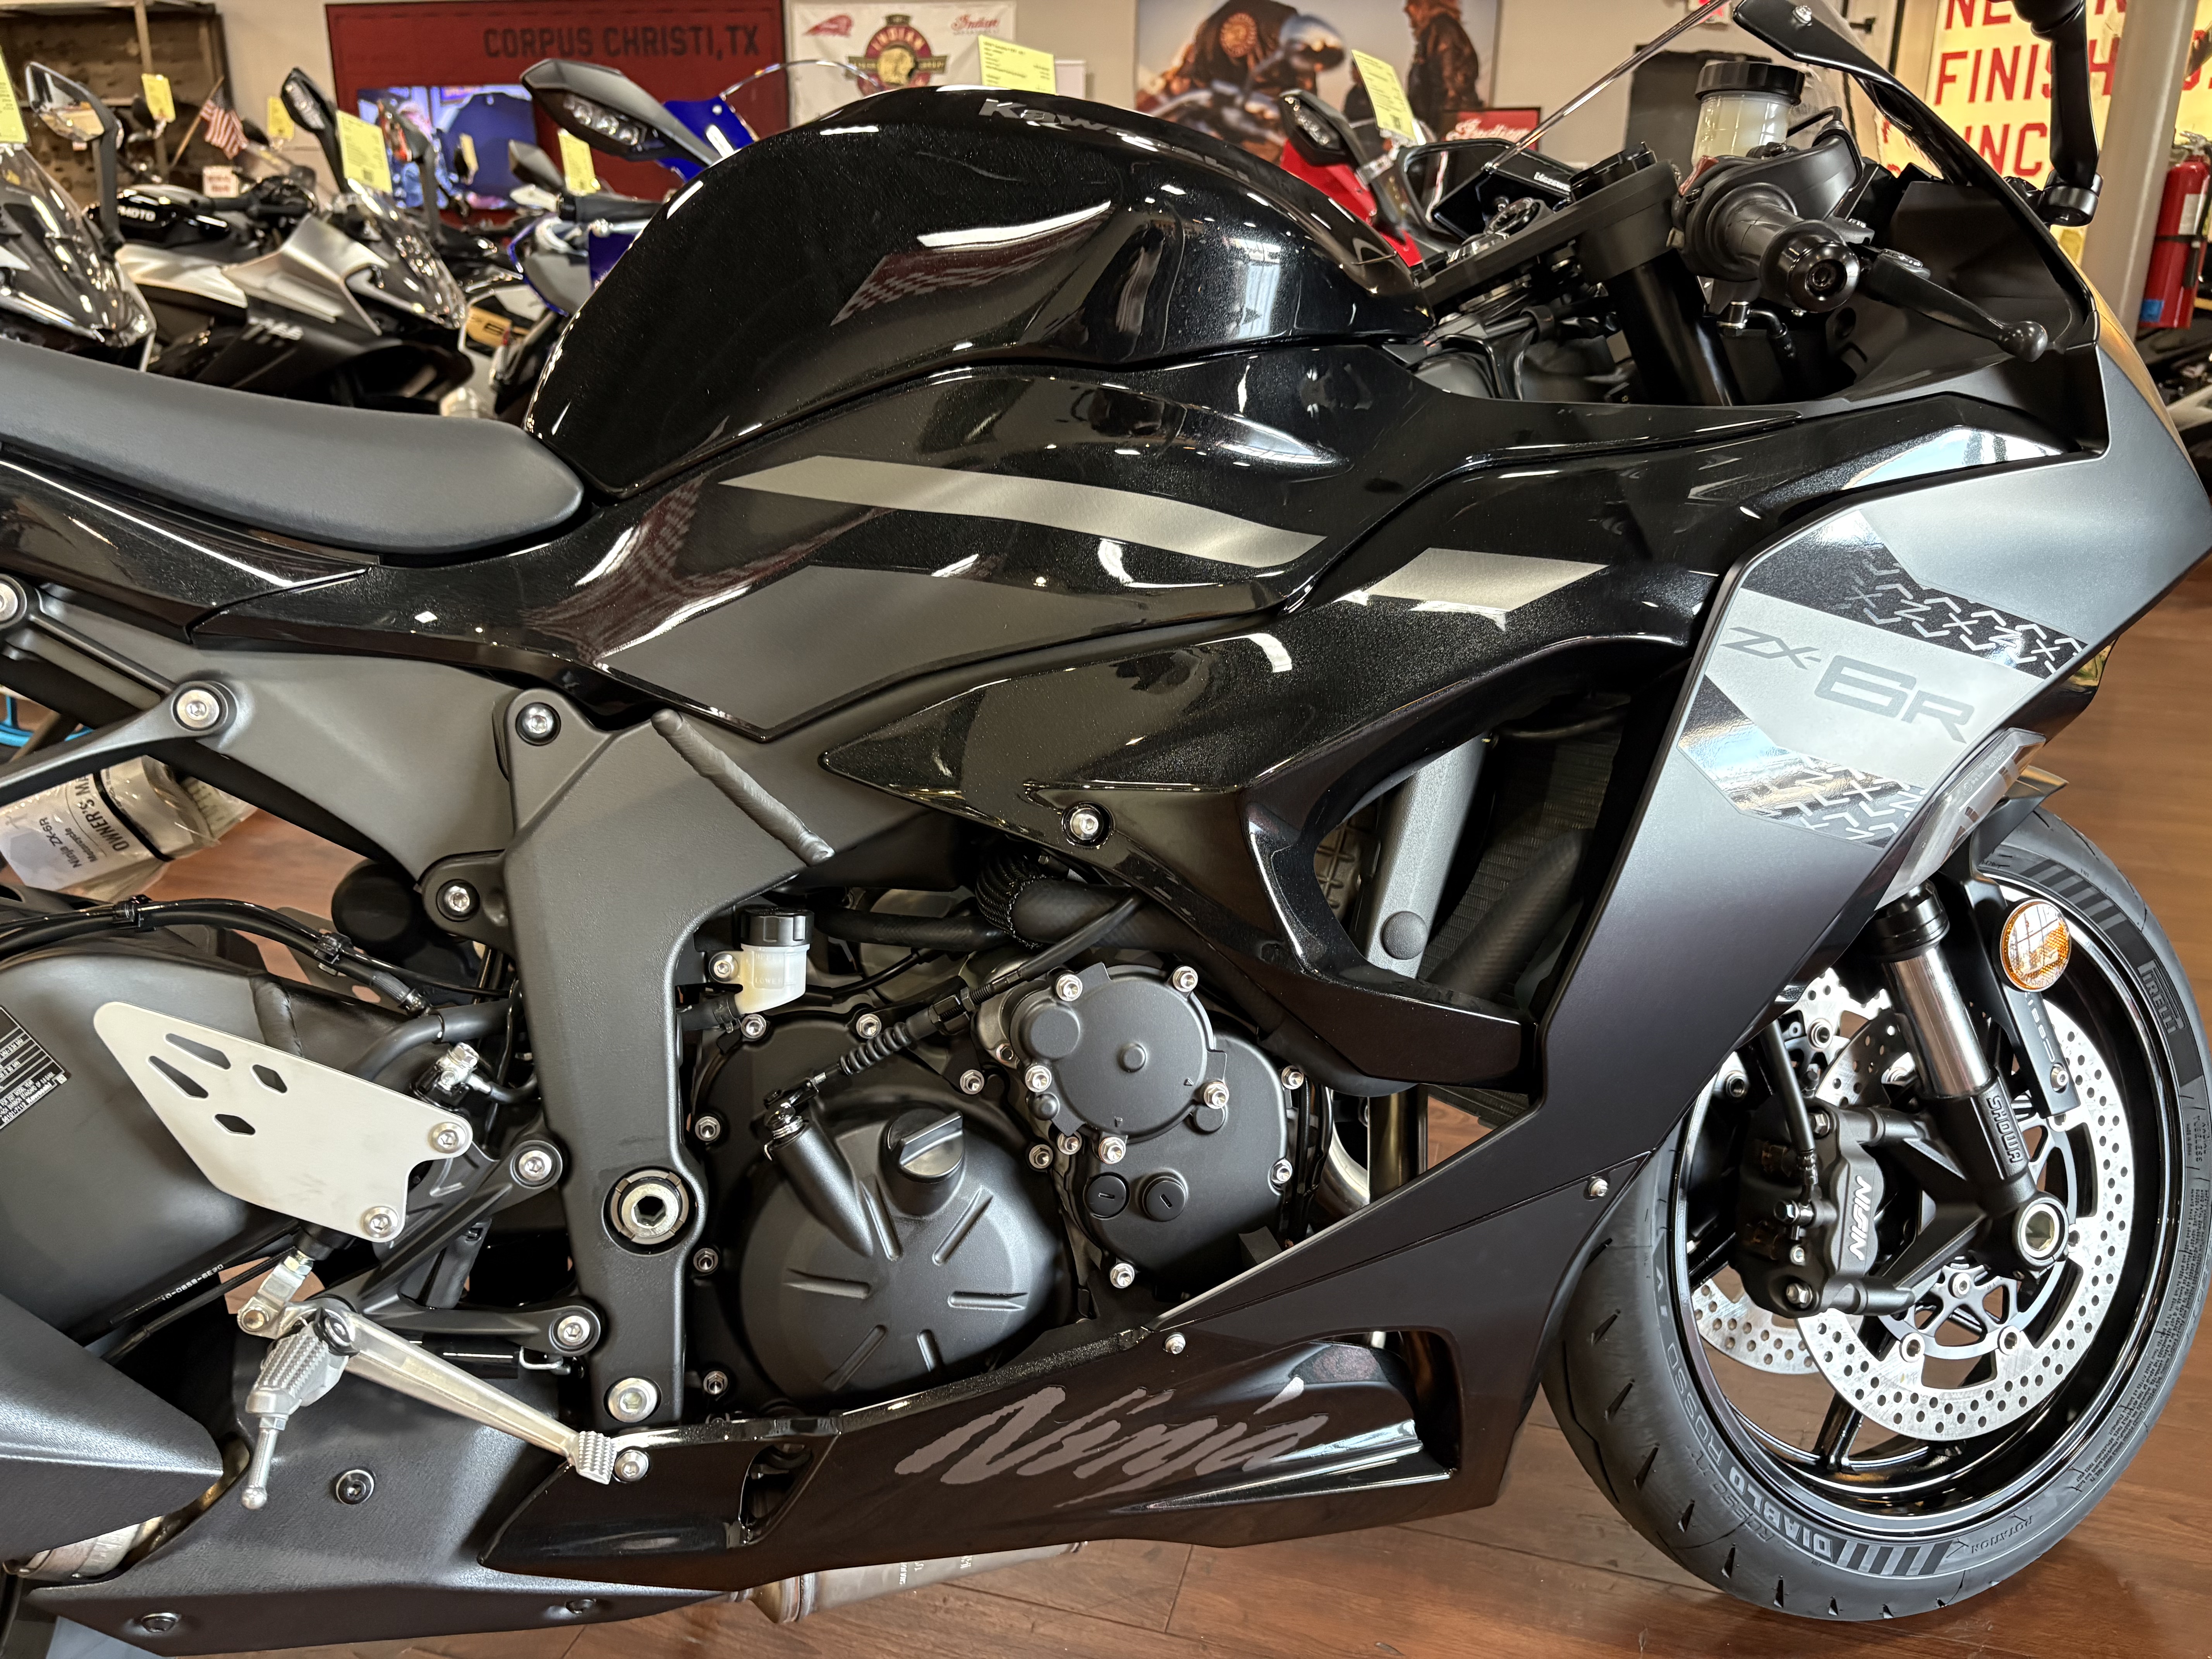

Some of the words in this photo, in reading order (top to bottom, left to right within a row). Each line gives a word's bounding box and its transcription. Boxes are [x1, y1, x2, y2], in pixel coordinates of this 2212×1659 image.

[483, 28, 594, 58] CORPUS
[603, 26, 723, 61] CHRISTI,
[726, 24, 760, 55] TX
[117, 205, 156, 222] MOTO
[1720, 625, 1975, 744] ZX-6R
[39, 817, 63, 847] ZX-6R
[65, 827, 98, 862] Motorcycle
[79, 799, 129, 852] OWNER'S
[60, 845, 82, 868] Ninja
[2137, 959, 2186, 1035] PIRELLI
[1986, 1094, 2024, 1164] SHOWA
[2192, 1115, 2203, 1163] TUBELESS
[1668, 1342, 1724, 1466] ROSSO
[894, 1376, 1330, 1508] Ninja
[1711, 1481, 1775, 1543] ROSSO
[1729, 1466, 1834, 1563] DIABLO
[1971, 1515, 2032, 1554] ROTATION
